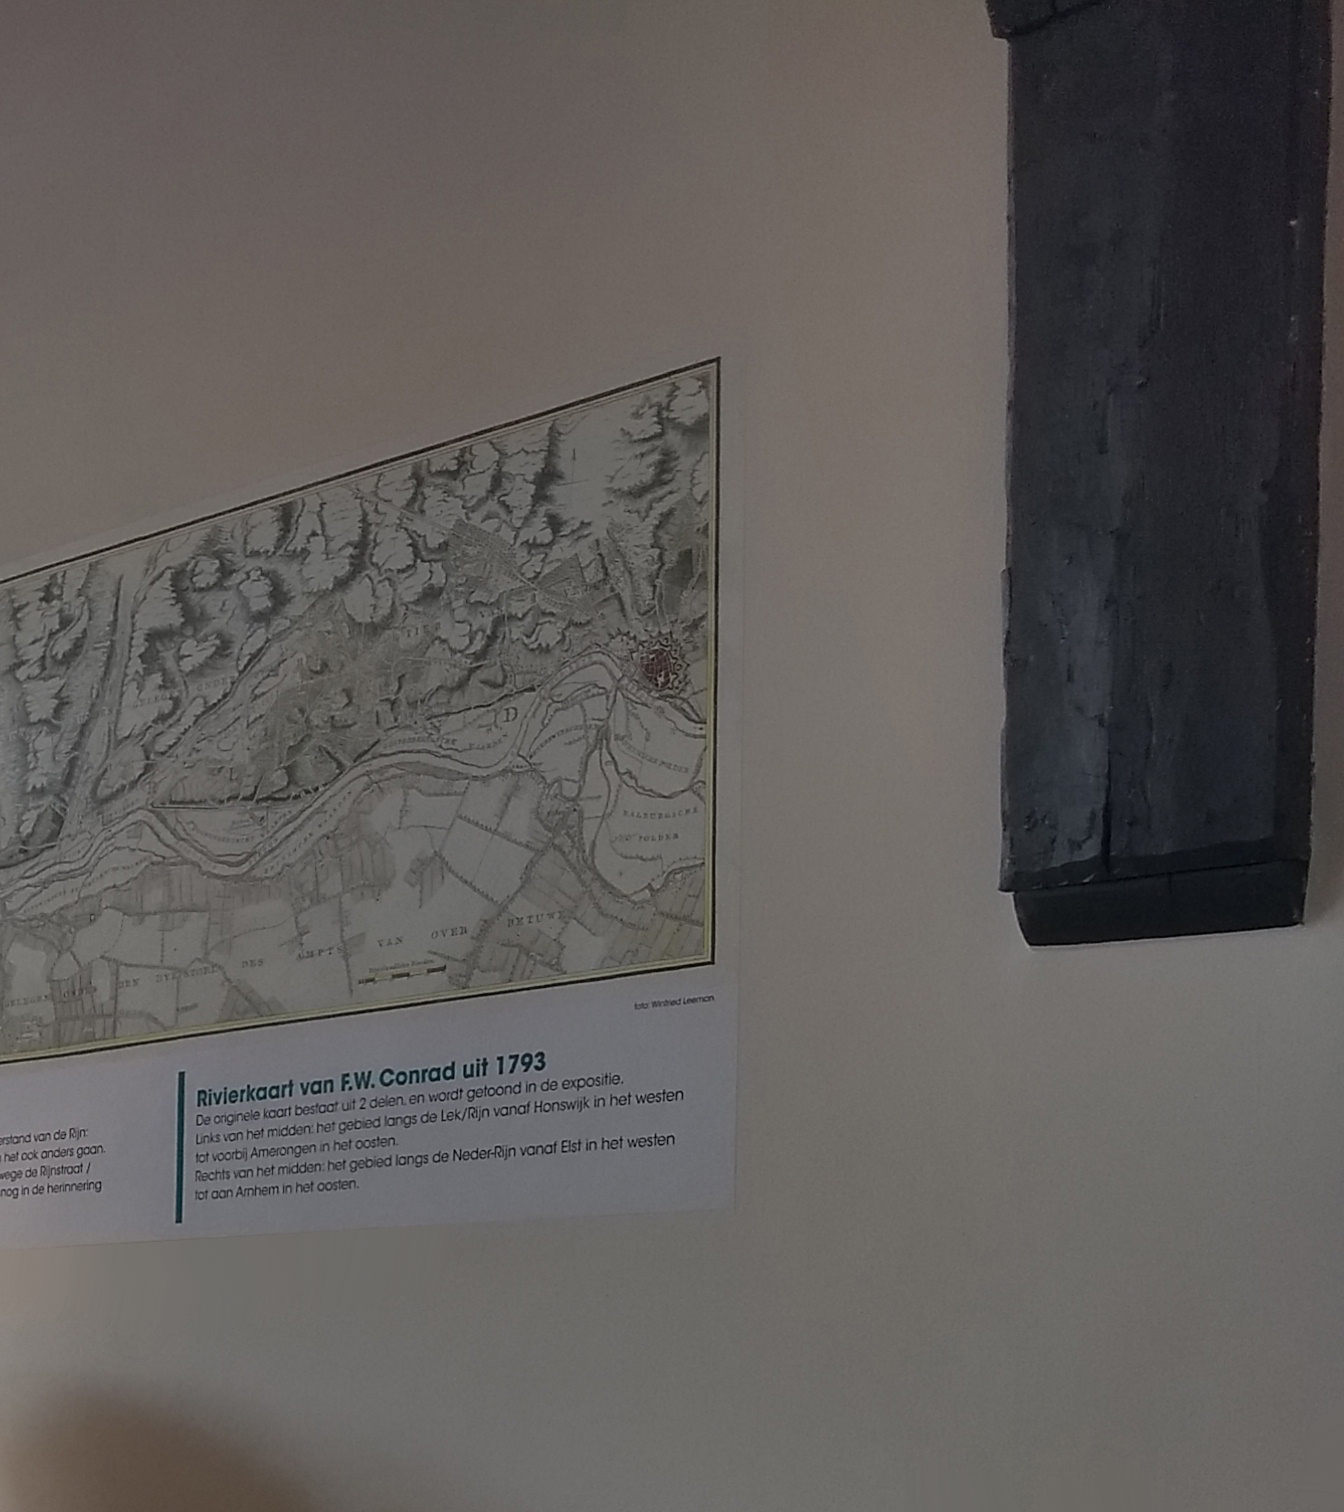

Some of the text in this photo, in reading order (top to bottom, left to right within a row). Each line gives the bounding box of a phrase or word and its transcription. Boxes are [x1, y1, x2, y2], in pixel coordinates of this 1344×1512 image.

[197, 1051, 546, 1106] Rivierkaart van F.W. Conrad uit 1793
[195, 1113, 211, 1126] De
[213, 1109, 260, 1126] originele
[263, 1105, 292, 1119] kaart
[294, 1101, 338, 1116] bestaat
[341, 1098, 356, 1112] uit
[359, 1097, 366, 1110] 2
[408, 1095, 425, 1105] en
[428, 1088, 463, 1102] wordt
[466, 1082, 522, 1102] getoond
[525, 1081, 537, 1093] in
[540, 1079, 558, 1092] de
[561, 1073, 624, 1091] expositie.
[195, 1132, 220, 1144] Links
[223, 1132, 244, 1142] van
[246, 1127, 264, 1140] het
[316, 1121, 336, 1133] het
[338, 1116, 381, 1134] gebied
[384, 1114, 418, 1129] langs
[420, 1111, 438, 1124] de
[440, 1107, 490, 1122] Lek/Rijn
[493, 1102, 530, 1117] vanaf
[533, 1097, 590, 1113] Honswijk
[593, 1096, 606, 1108] in
[609, 1093, 632, 1106] het
[635, 1089, 684, 1104] westen
[33, 1134, 51, 1142] van
[53, 1130, 67, 1141] de
[3, 1151, 19, 1162] het
[20, 1149, 38, 1161] ook
[40, 1146, 74, 1159] anders
[76, 1146, 106, 1158] gaan.
[194, 1168, 230, 1181] Rechts
[233, 1168, 254, 1178] van
[256, 1164, 275, 1177] het
[327, 1159, 346, 1171] het
[348, 1155, 392, 1172] gebied
[395, 1153, 429, 1168] langs
[432, 1150, 449, 1163] de
[452, 1145, 516, 1161] Neder-Rijn
[519, 1141, 557, 1156] vanaf
[560, 1139, 582, 1153] Elst
[585, 1138, 598, 1151] in
[600, 1136, 623, 1150] het
[626, 1133, 675, 1148] westen
[195, 1137, 398, 1163] tot voorbij Amerongen in het oosten.
[24, 1167, 38, 1178] de
[39, 1163, 83, 1179] Rijnstraat
[0, 1189, 19, 1200] nog
[20, 1185, 30, 1196] in
[31, 1184, 45, 1195] de
[46, 1180, 102, 1193] herinnering
[194, 1179, 359, 1200] tot aan Arnhem in het oosten.
